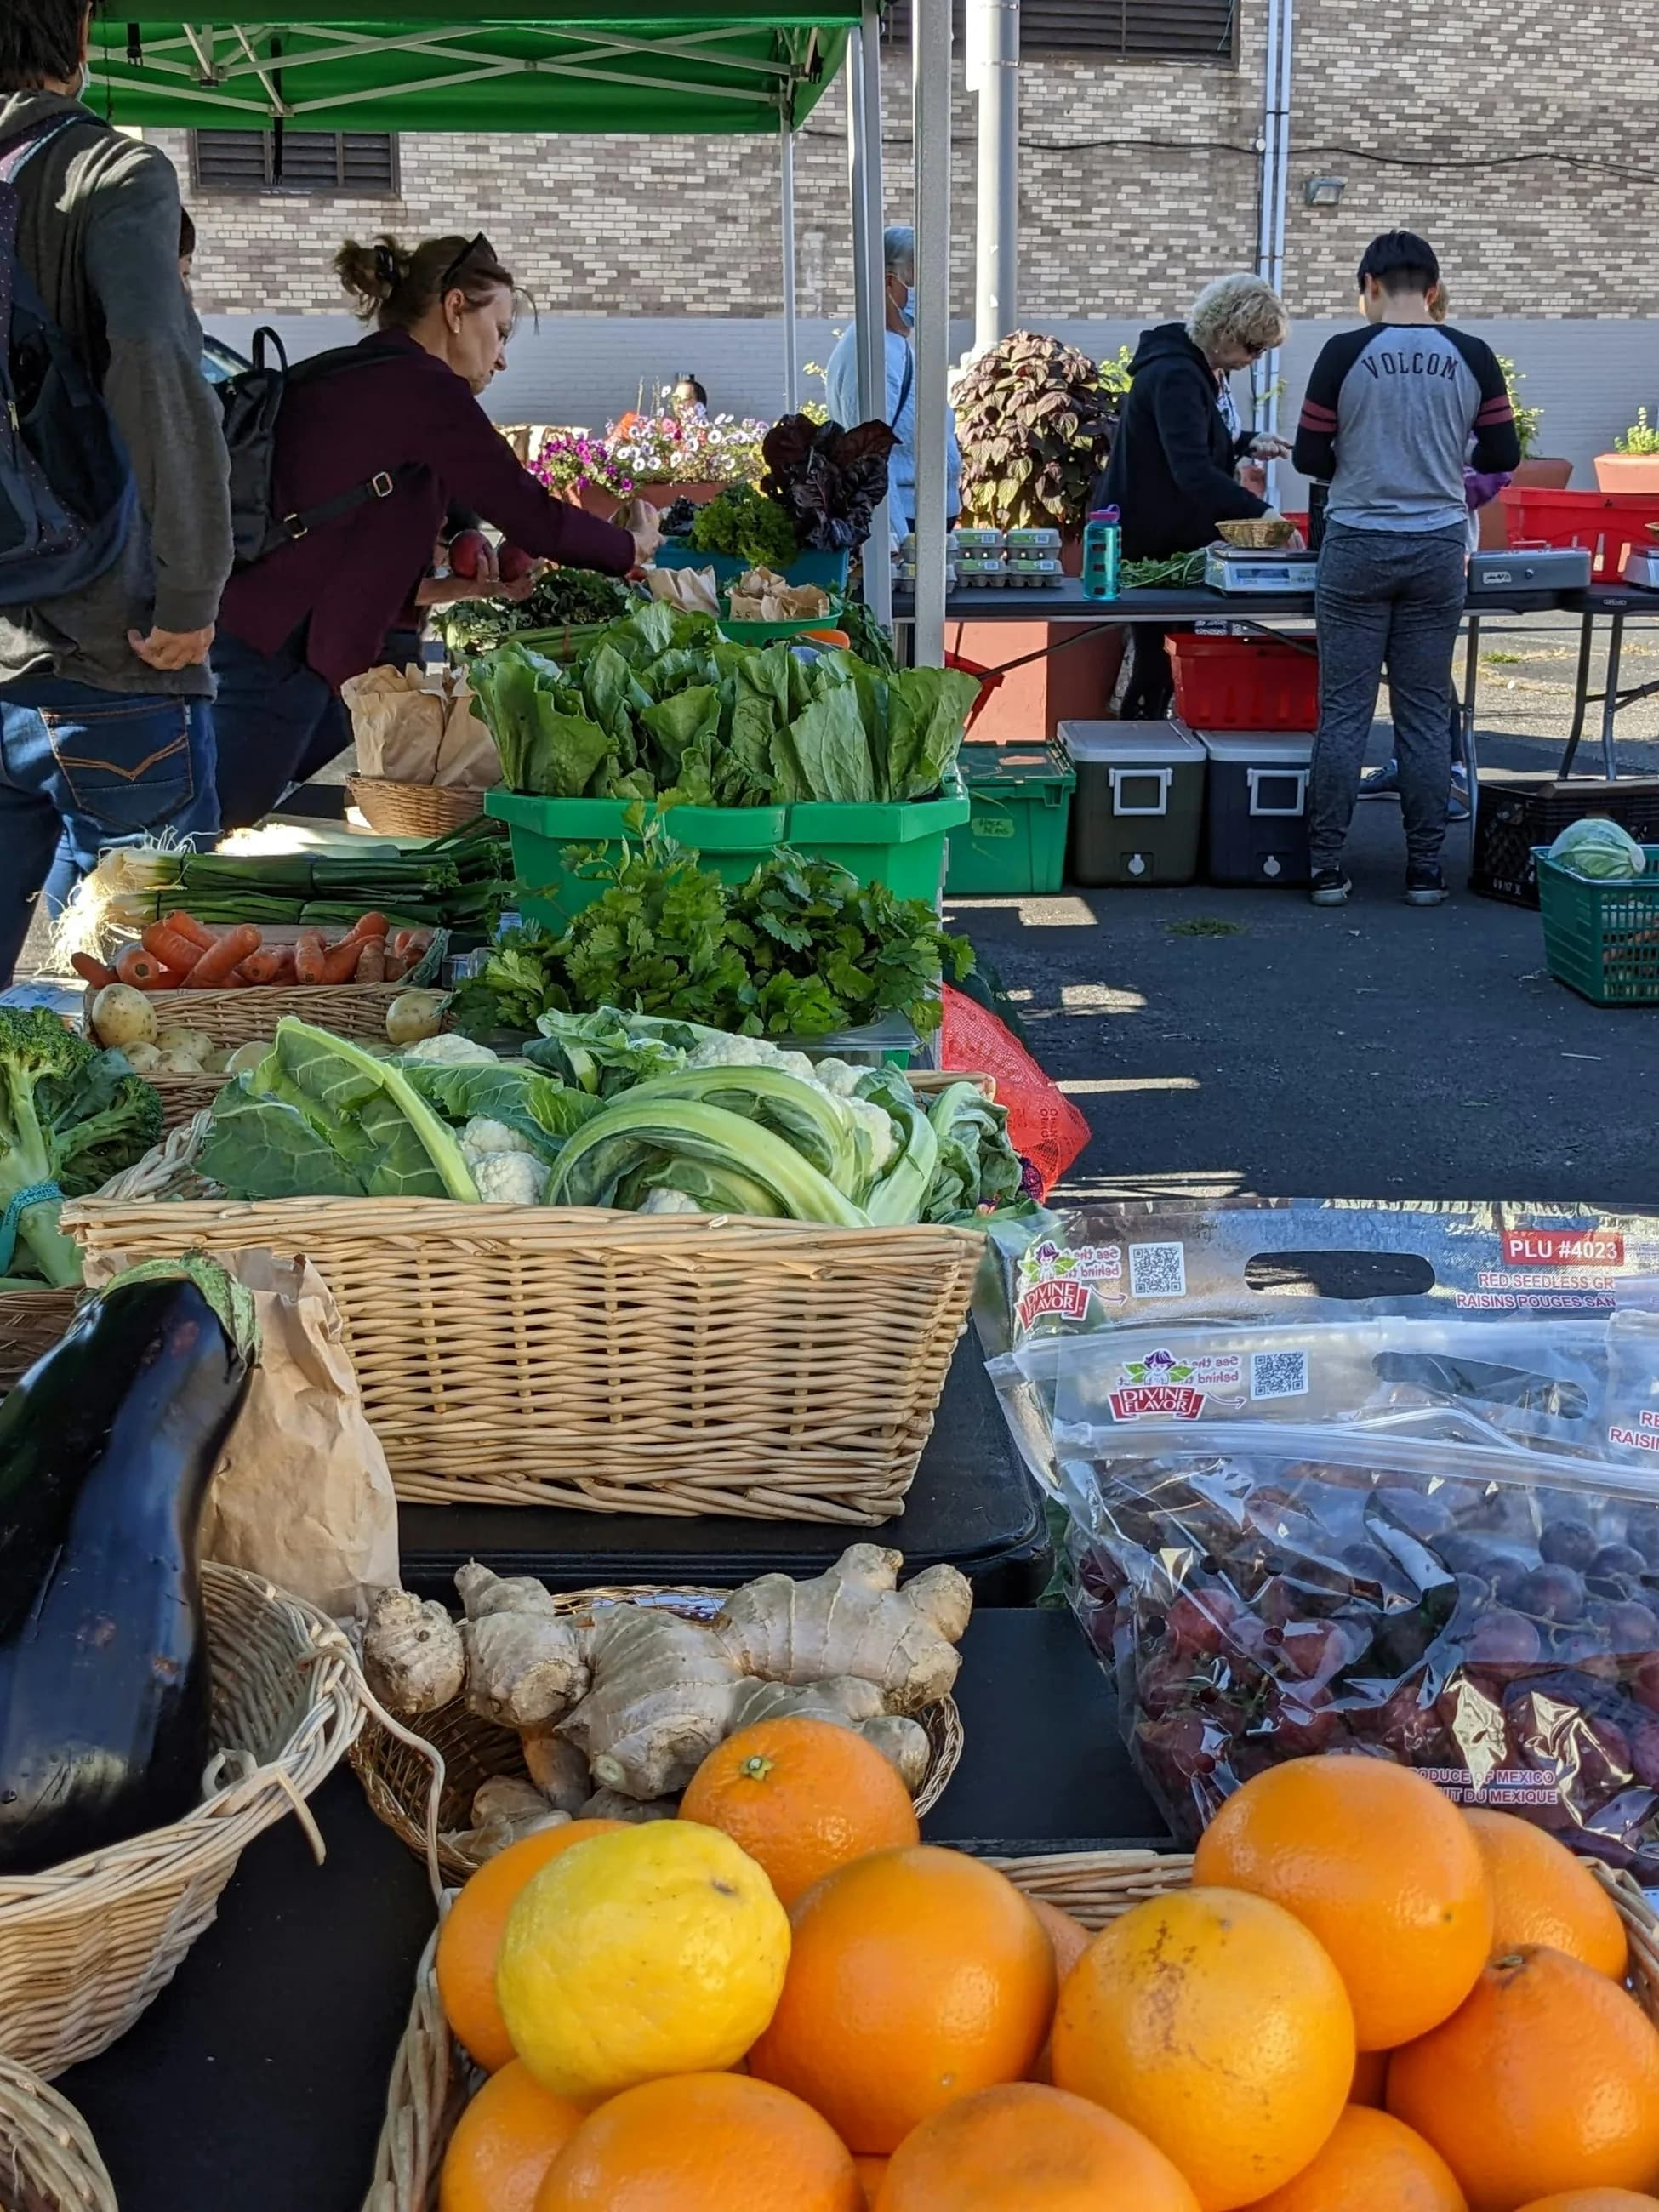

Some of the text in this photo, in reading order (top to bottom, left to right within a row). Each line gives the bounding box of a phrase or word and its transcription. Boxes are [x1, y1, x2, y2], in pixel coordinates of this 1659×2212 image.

[1361, 352, 1458, 380] VOLCOM
[1510, 1240, 1553, 1258] PLU
[1559, 1240, 1617, 1260] #4023
[1479, 1274, 1509, 1288] RED
[1514, 1274, 1589, 1289] SEEDLESS
[1026, 1282, 1077, 1308] DIVINE
[1457, 1294, 1517, 1308] RAISINS
[1028, 1295, 1075, 1317] FLAVOR
[1123, 1388, 1190, 1401] DIVINE
[1125, 1399, 1188, 1412] FLAVOR
[1412, 1768, 1472, 1783] ODUCE
[1497, 1770, 1555, 1784] MEXICO
[1464, 1788, 1486, 1802] DU
[1491, 1789, 1558, 1804] MEXIQUE
